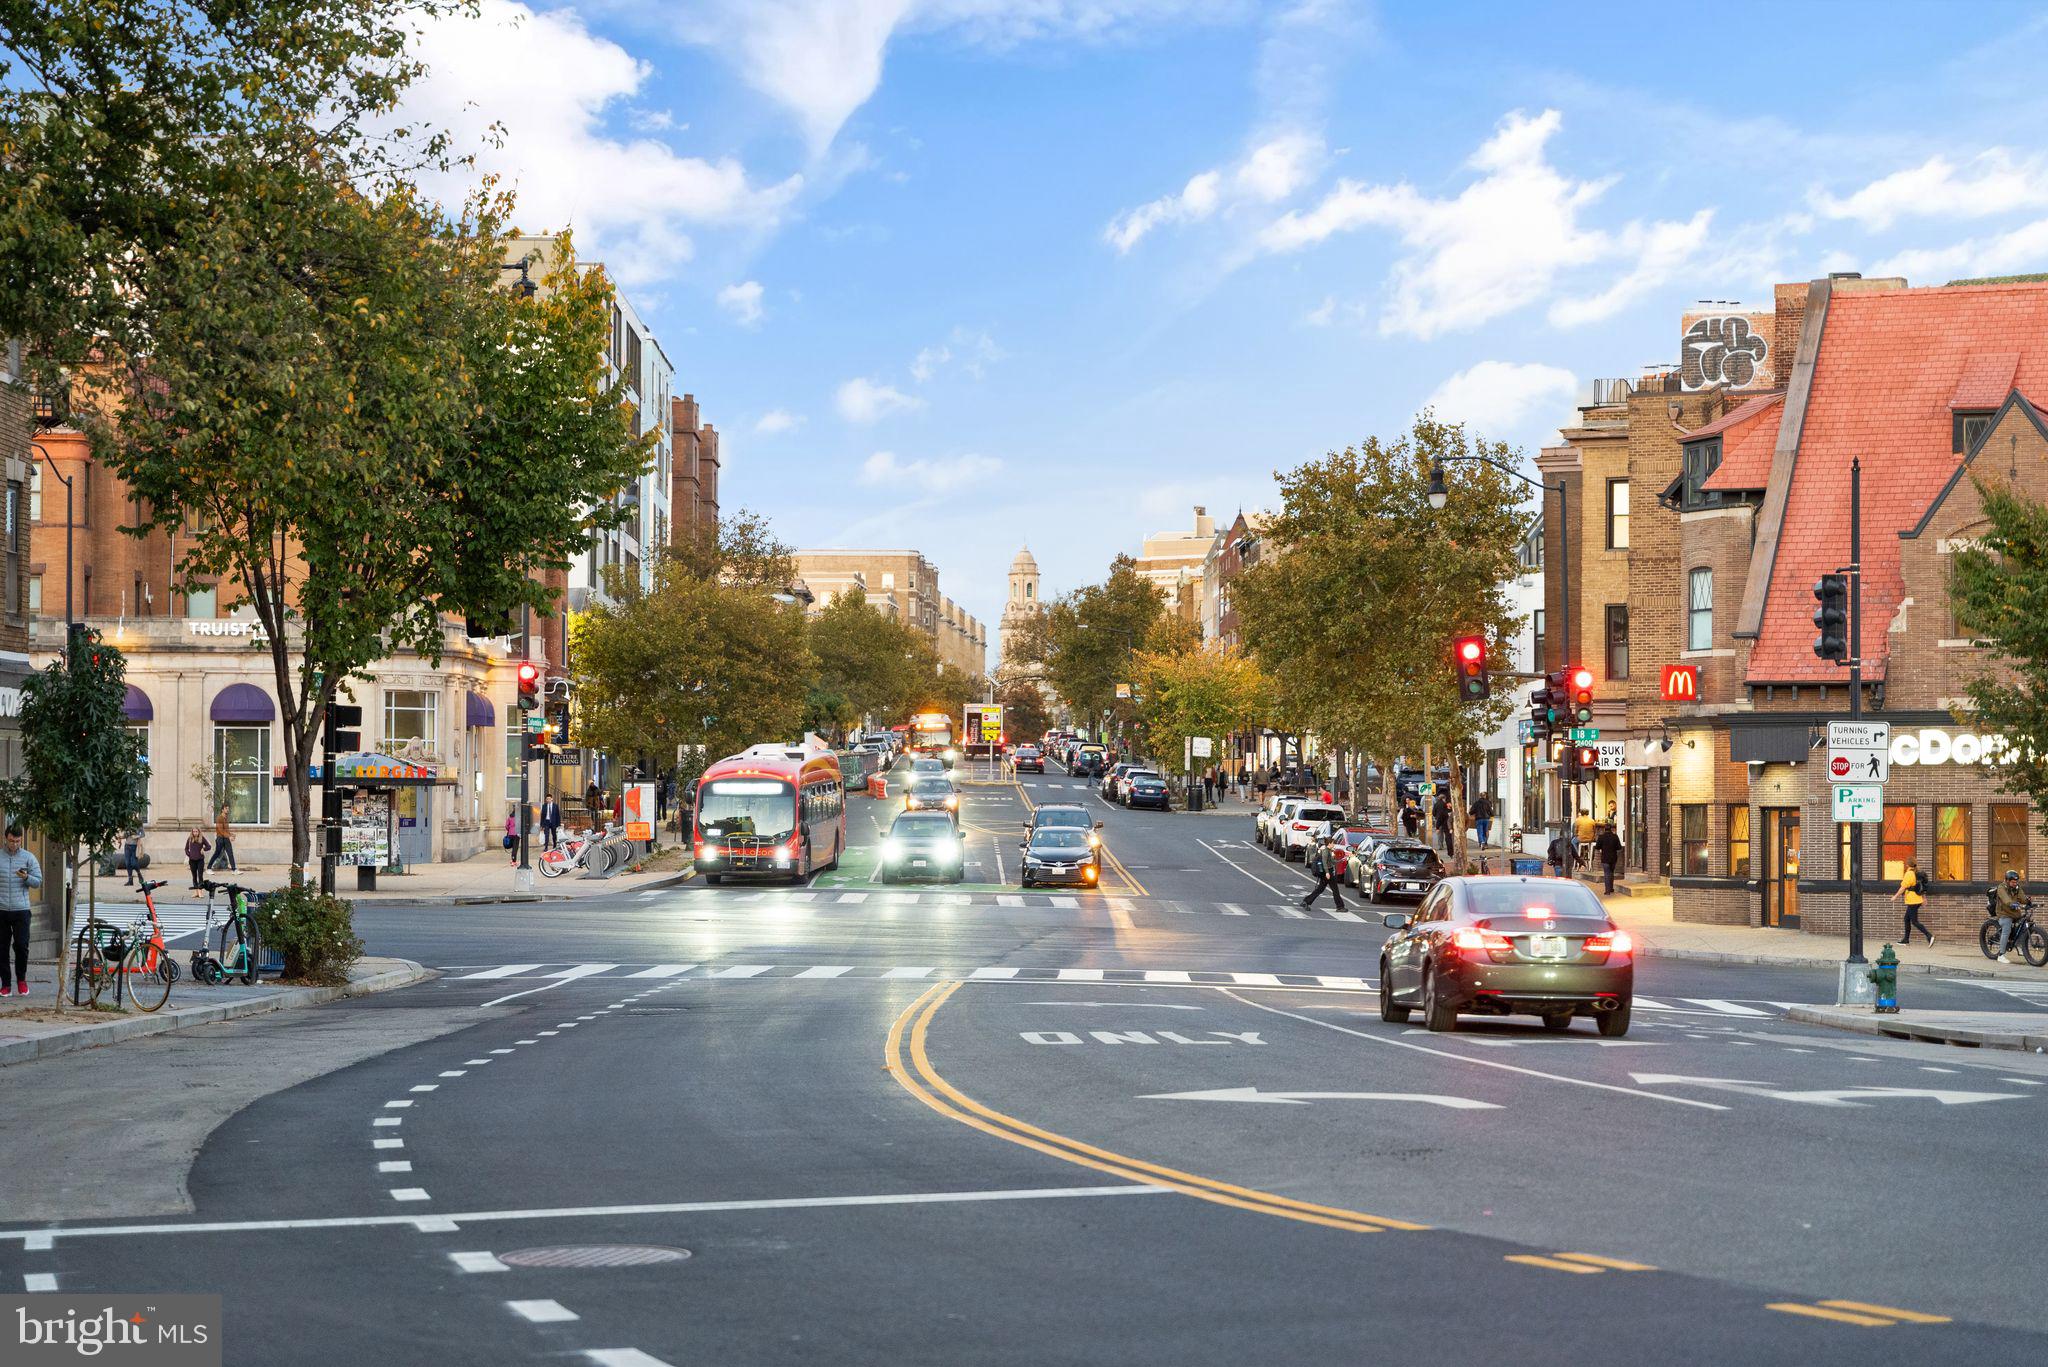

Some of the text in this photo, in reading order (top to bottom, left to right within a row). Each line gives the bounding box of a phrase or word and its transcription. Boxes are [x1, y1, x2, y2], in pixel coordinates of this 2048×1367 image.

[189, 622, 250, 636] TRUIST
[1577, 730, 1585, 738] 18
[1834, 726, 1868, 735] TURNING
[1831, 737, 1870, 745] VEHICLES
[1832, 762, 1849, 770] STOP
[351, 765, 428, 778] MORGAN
[1019, 1031, 1269, 1044] ONLY
